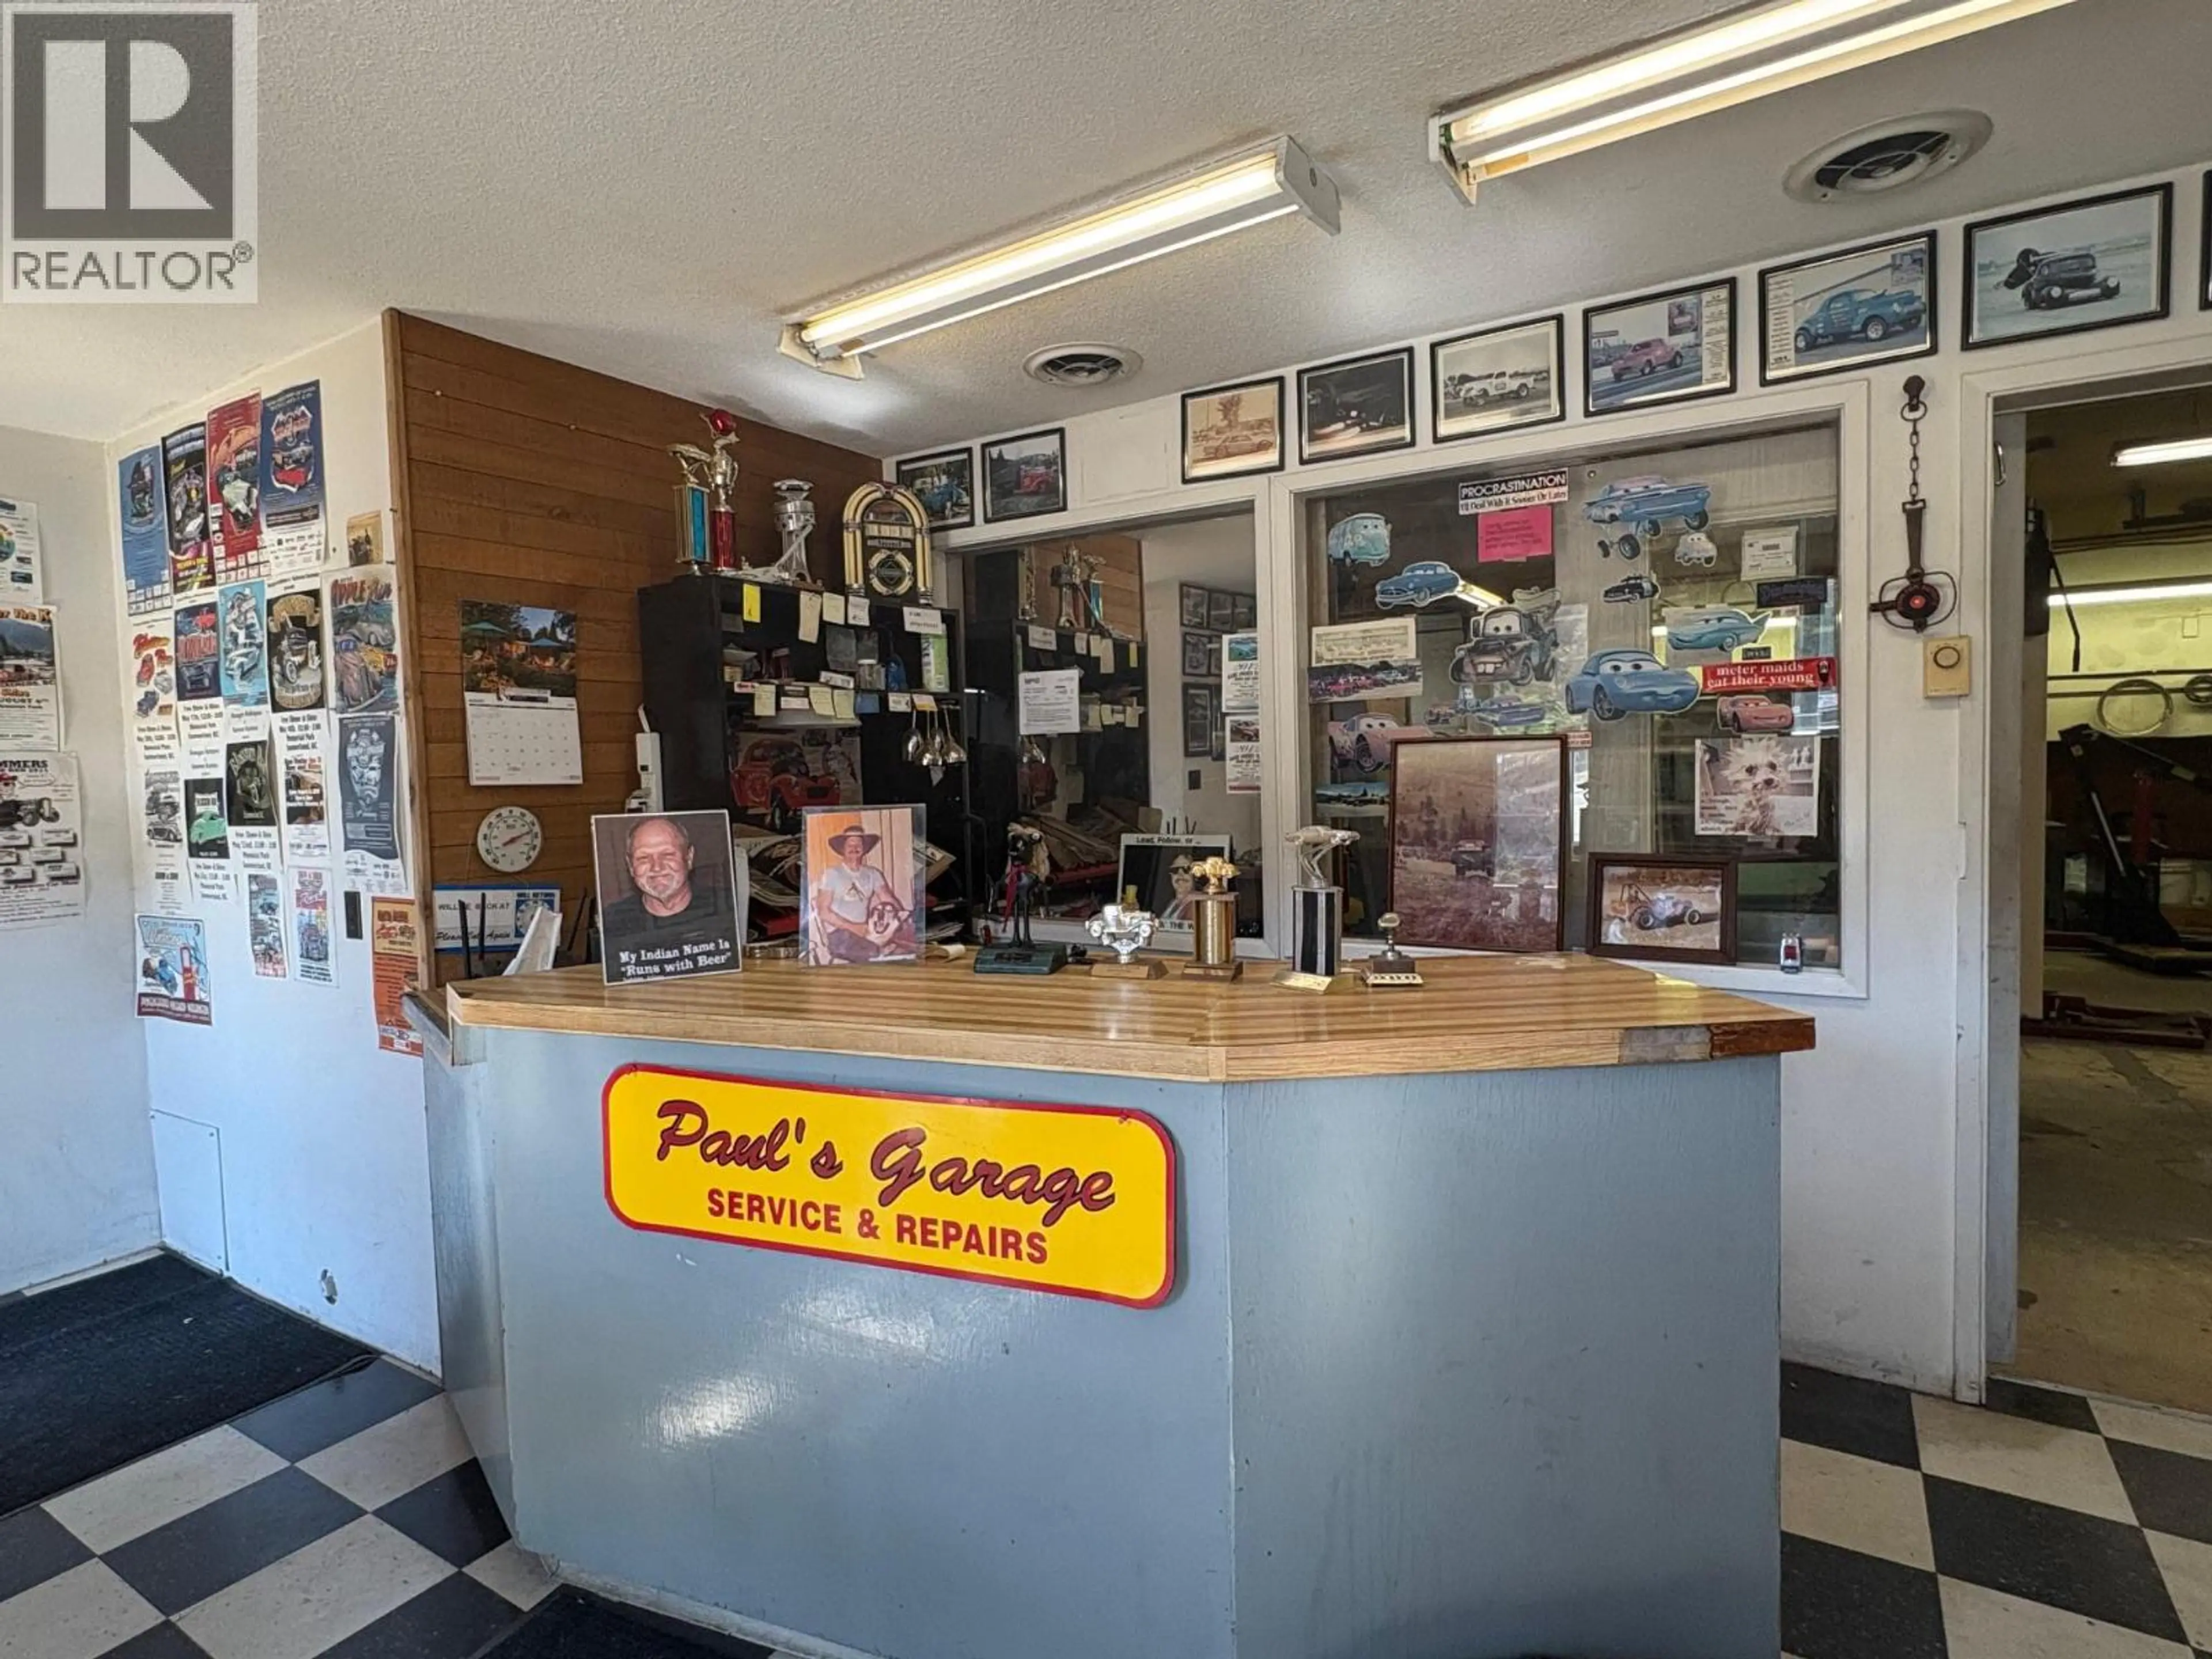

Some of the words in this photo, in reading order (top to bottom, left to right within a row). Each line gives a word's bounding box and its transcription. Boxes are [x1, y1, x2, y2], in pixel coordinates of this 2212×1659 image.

[1461, 473, 1566, 499] PROCRASTINATION
[1717, 664, 1758, 676] meter
[1761, 660, 1804, 673] maids
[1707, 676, 1728, 688] eat
[1731, 673, 1767, 687] their
[1769, 673, 1814, 686] young
[619, 950, 637, 964] My
[640, 948, 680, 960] Indian
[683, 942, 716, 956] Name
[664, 959, 694, 973] with
[656, 1100, 844, 1180] Paul's
[871, 1127, 1116, 1228] Garage
[707, 1188, 842, 1234] SERVICE
[857, 1207, 880, 1241] &
[896, 1214, 1048, 1264] REPAIRS
